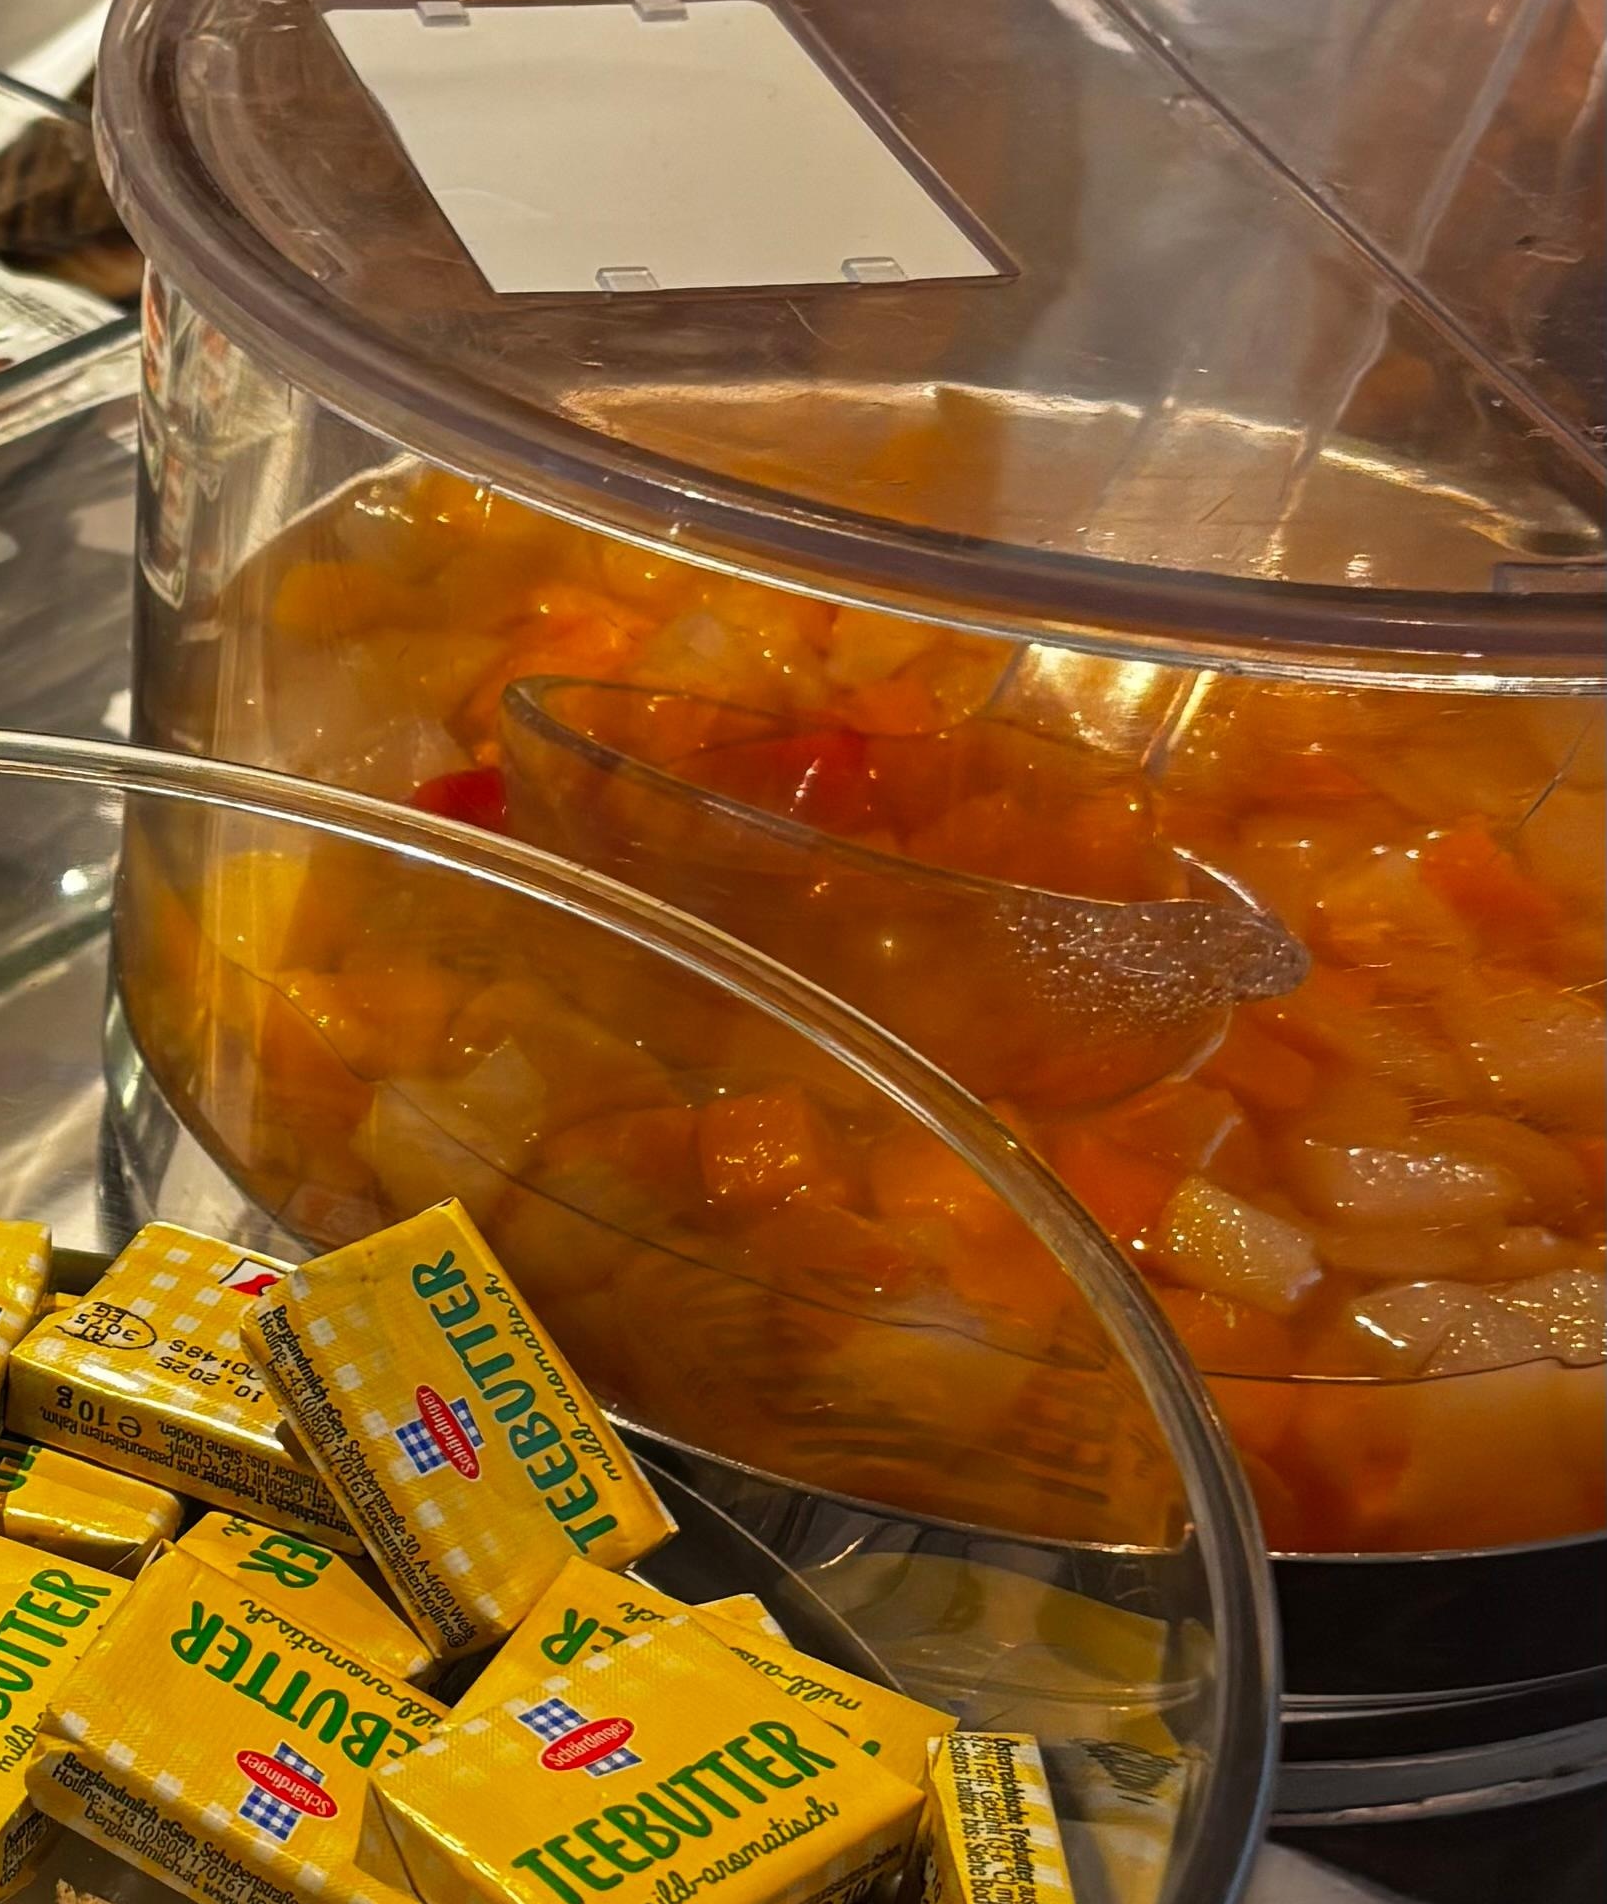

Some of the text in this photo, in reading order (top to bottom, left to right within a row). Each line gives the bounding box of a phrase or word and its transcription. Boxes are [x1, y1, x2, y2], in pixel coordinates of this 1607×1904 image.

[77, 1324, 107, 1344] AT
[93, 1304, 125, 1323] EG
[50, 1385, 75, 1411] g
[153, 1354, 265, 1404] 10.2025
[483, 1272, 622, 1482] mild-aromatisch
[35, 1406, 80, 1434] Rahm,
[74, 1399, 114, 1430] 10
[411, 1249, 620, 1555] TEEBUTTER
[78, 1422, 175, 1467] pasteurisiertem
[153, 1420, 205, 1449] Boden.
[203, 1440, 244, 1465] Siehe
[419, 1390, 478, 1476] Schärdinger
[174, 1459, 199, 1477] aus
[264, 1304, 334, 1405] Berglandmilch
[341, 1436, 410, 1539] Schubertstraße
[412, 1554, 456, 1612] A-4600
[197, 1467, 265, 1503] Teebutter
[239, 1599, 444, 1731] ild-aromatisch
[545, 1719, 631, 1769] Schärdinger
[57, 1750, 164, 1825] Berglandmilch
[241, 1752, 332, 1816] Schärdinger
[48, 1763, 112, 1811] Hotline:
[104, 1802, 139, 1831] +43
[133, 1820, 190, 1863] (0)800
[183, 1852, 248, 1899] 170161
[964, 1841, 990, 1877] Siehe
